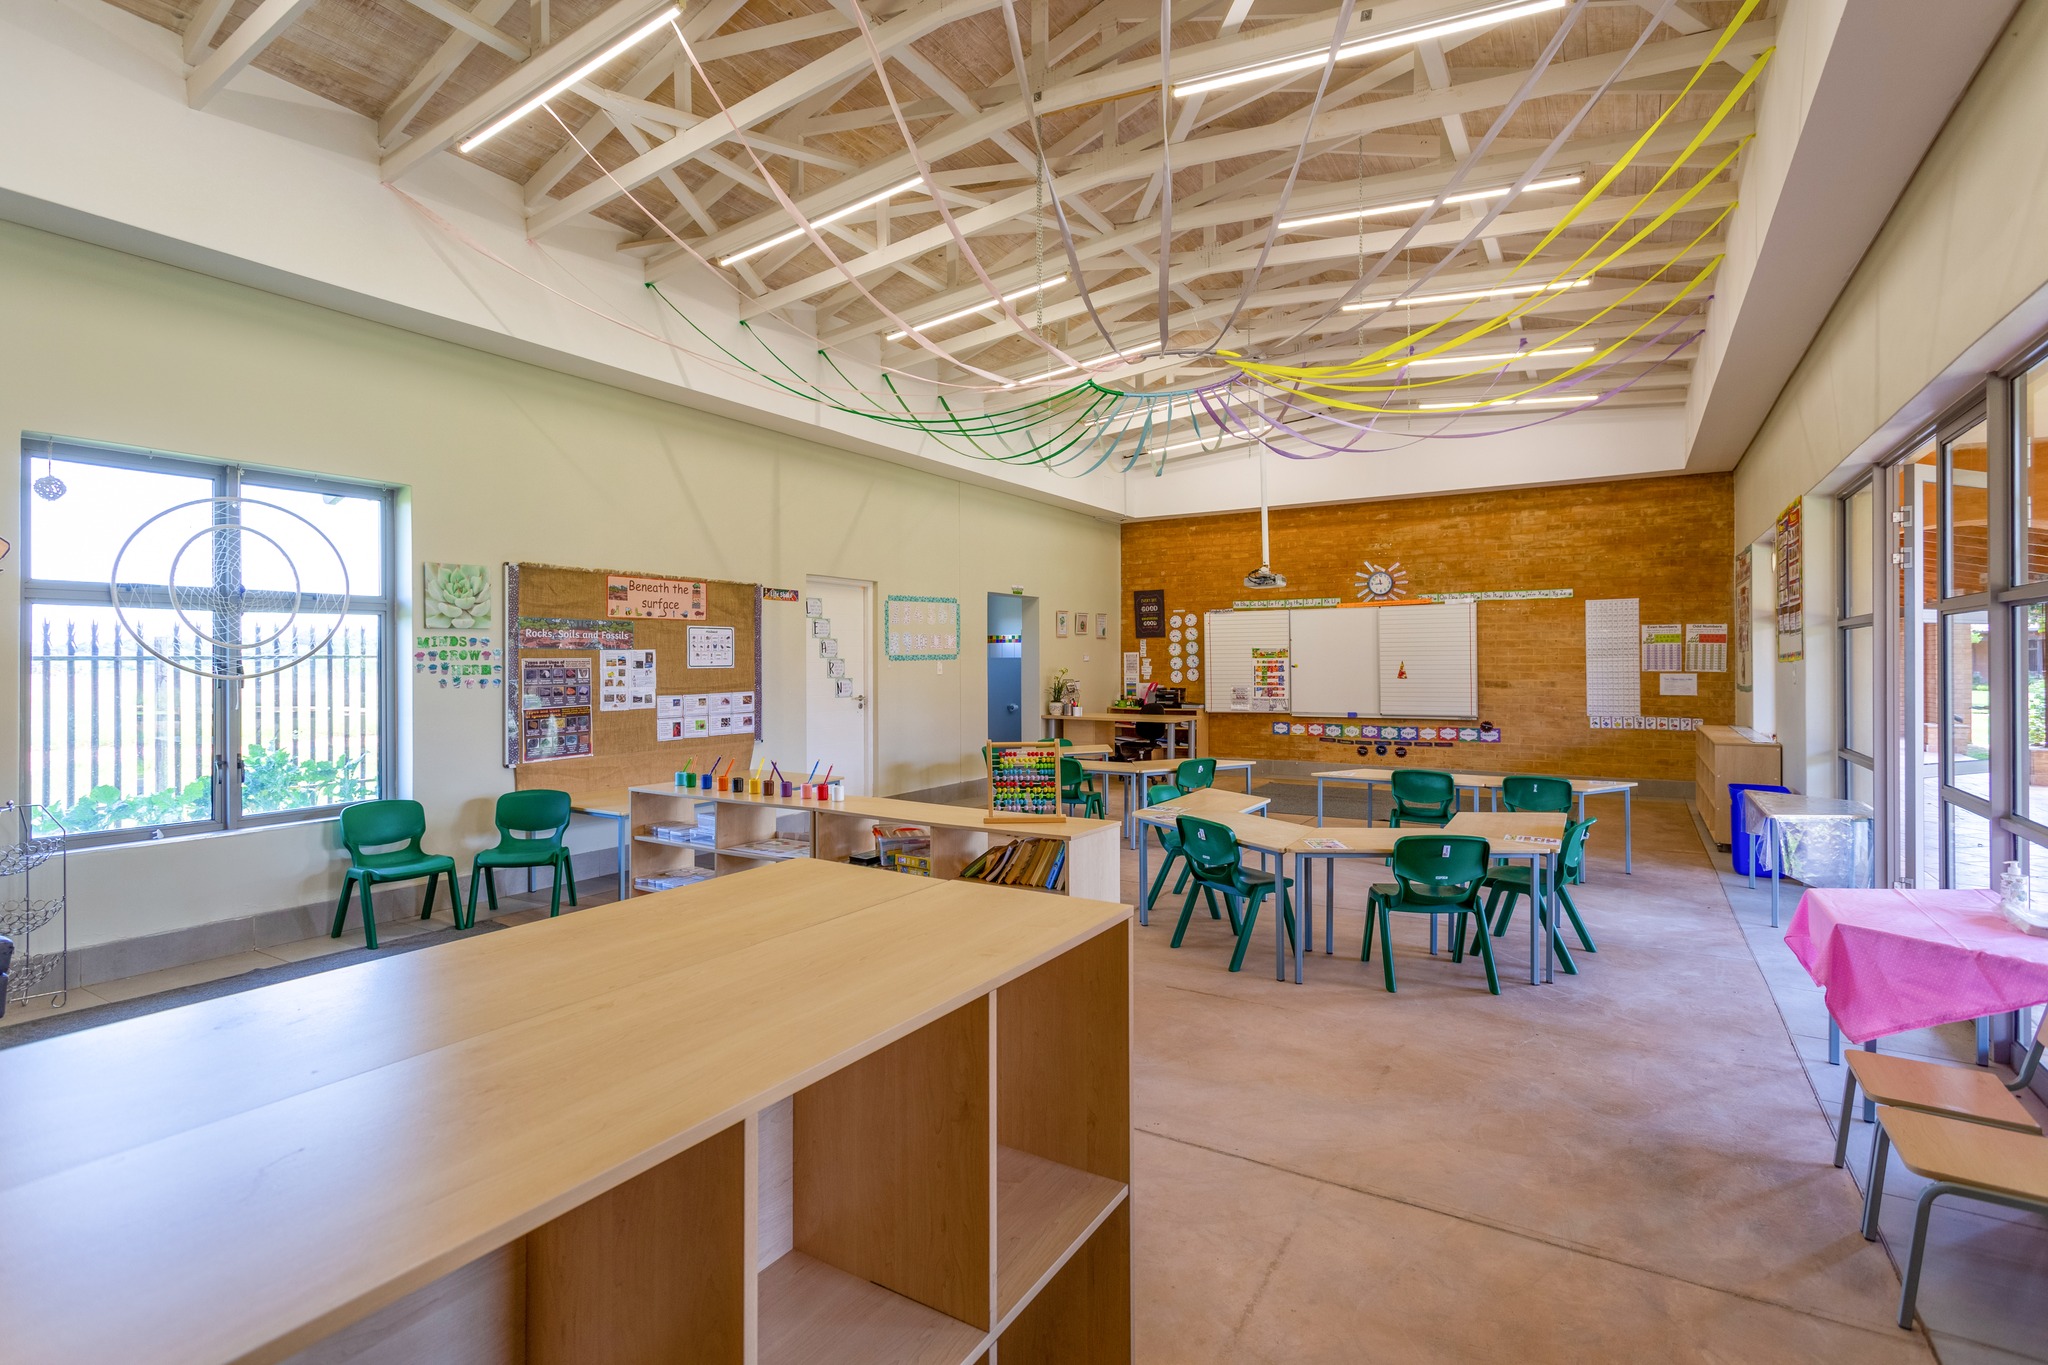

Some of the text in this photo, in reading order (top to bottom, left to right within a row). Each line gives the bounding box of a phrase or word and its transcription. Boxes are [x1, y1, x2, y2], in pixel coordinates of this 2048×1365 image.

[629, 580, 689, 594] Beneath the
[642, 598, 680, 610] surface
[526, 628, 555, 639] Rocks,
[558, 630, 580, 639] Soils
[602, 631, 629, 640] Fossils
[417, 636, 467, 648] MINDS
[439, 650, 481, 660] GROW
